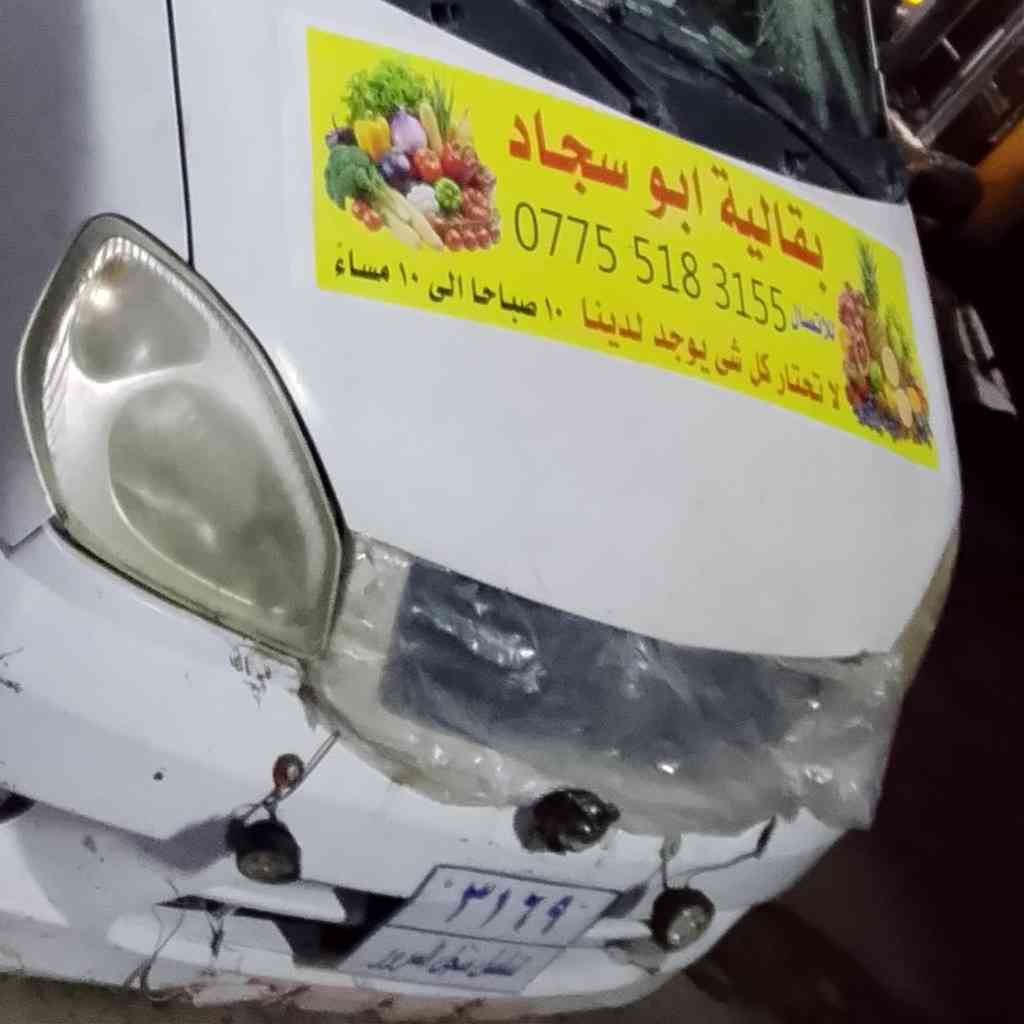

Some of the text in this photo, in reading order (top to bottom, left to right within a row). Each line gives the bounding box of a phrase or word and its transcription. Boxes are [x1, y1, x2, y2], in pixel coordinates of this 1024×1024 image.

[508, 109, 827, 294] بقالية ابو سجاد
[514, 201, 618, 274] 0775
[632, 235, 702, 299] 518
[712, 262, 787, 333] 3155
[471, 276, 538, 324] صباحا
[581, 296, 643, 349] لدينا
[653, 323, 711, 375] يوجد
[750, 352, 772, 387] كل
[828, 379, 840, 410] لا
